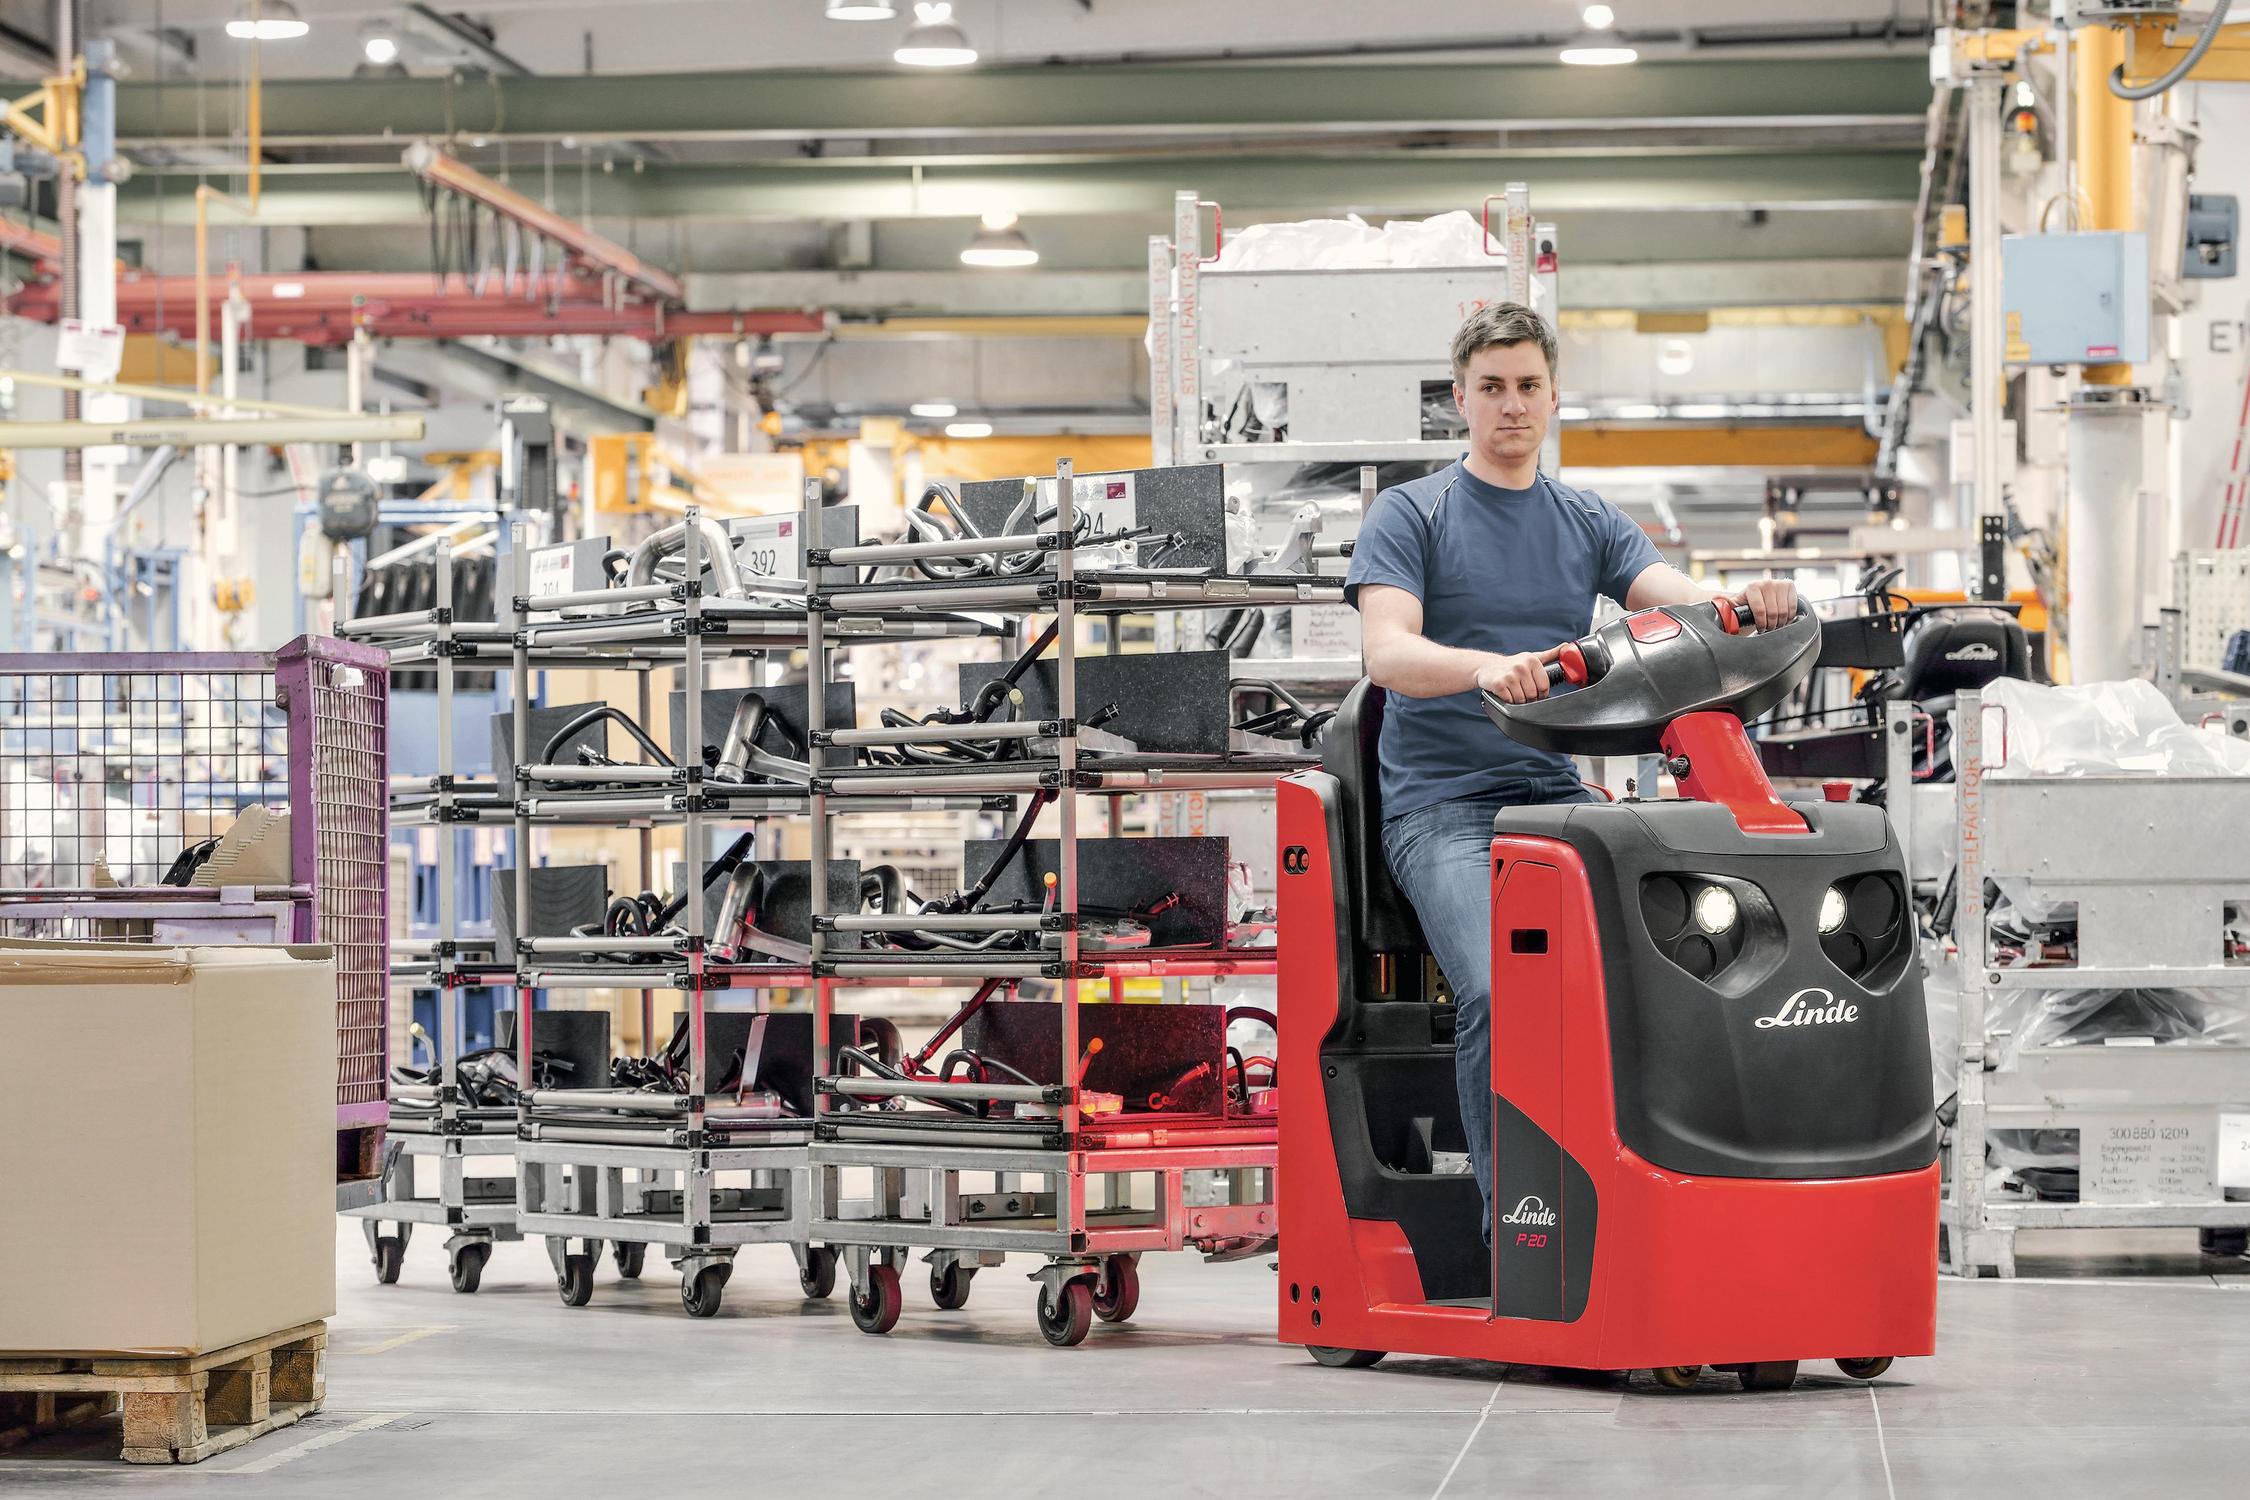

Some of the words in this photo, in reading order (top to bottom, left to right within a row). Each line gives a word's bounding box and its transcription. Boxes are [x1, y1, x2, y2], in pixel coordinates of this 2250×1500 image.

[751, 549, 776, 575] 392
[1963, 756, 1979, 915] STAPELFAKTOR
[1754, 987, 1859, 1029] Linde
[2159, 1127, 2189, 1140] 1209
[1502, 1195, 1557, 1226] Linde
